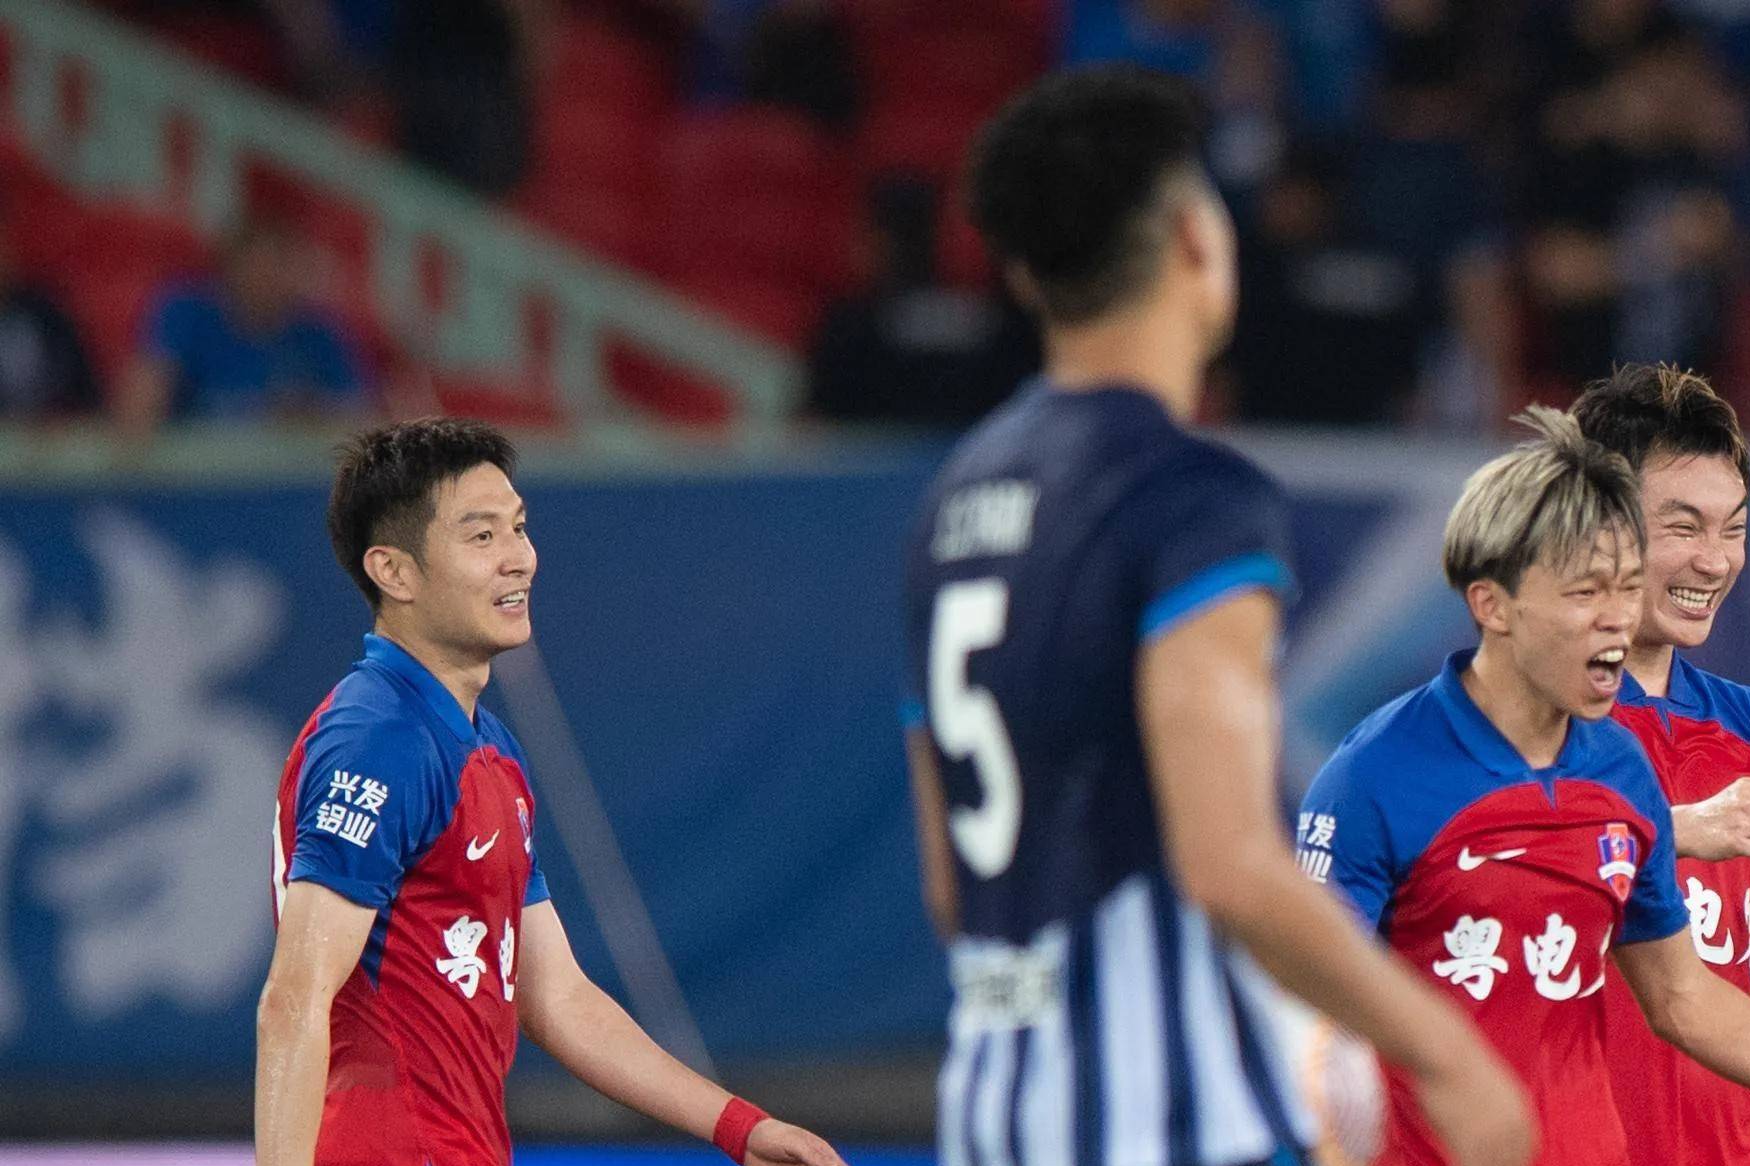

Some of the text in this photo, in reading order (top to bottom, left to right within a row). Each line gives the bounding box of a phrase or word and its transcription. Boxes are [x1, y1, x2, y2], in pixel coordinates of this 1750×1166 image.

[929, 577, 1022, 878] 5
[327, 769, 388, 817] 兴发
[314, 802, 376, 848] 铝业
